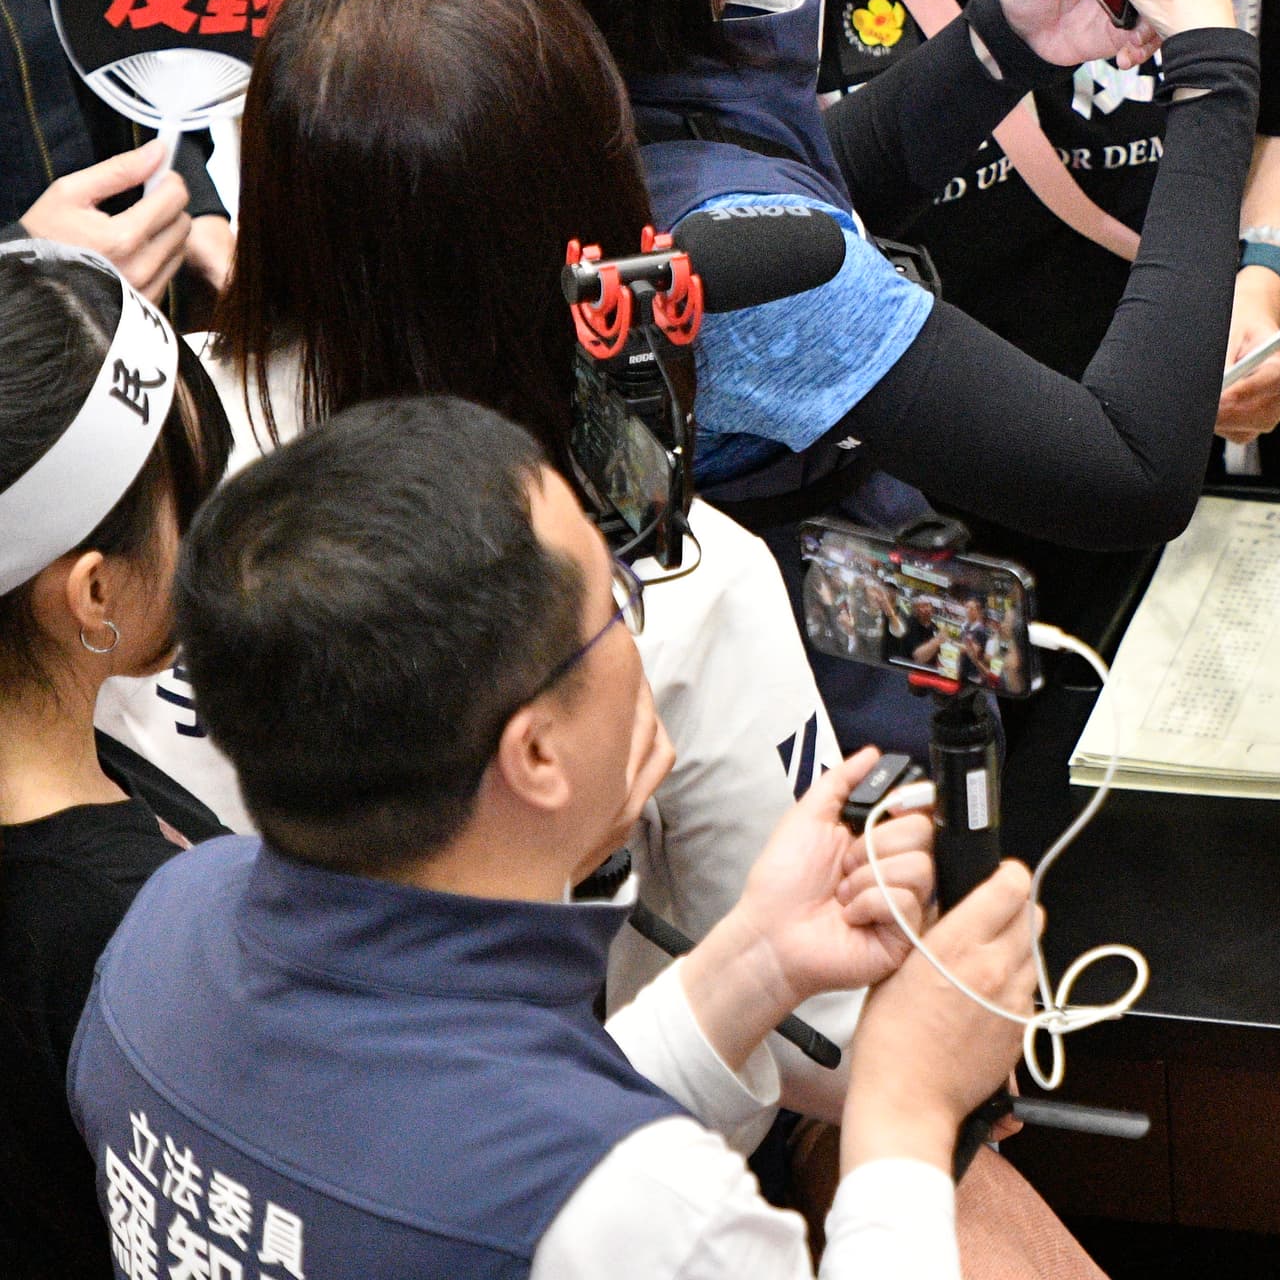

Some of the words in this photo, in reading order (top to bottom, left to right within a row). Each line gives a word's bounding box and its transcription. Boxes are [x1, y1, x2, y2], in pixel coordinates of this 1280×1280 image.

[106, 1144, 300, 1280] 羅智
[128, 1110, 306, 1280] 立法委員
